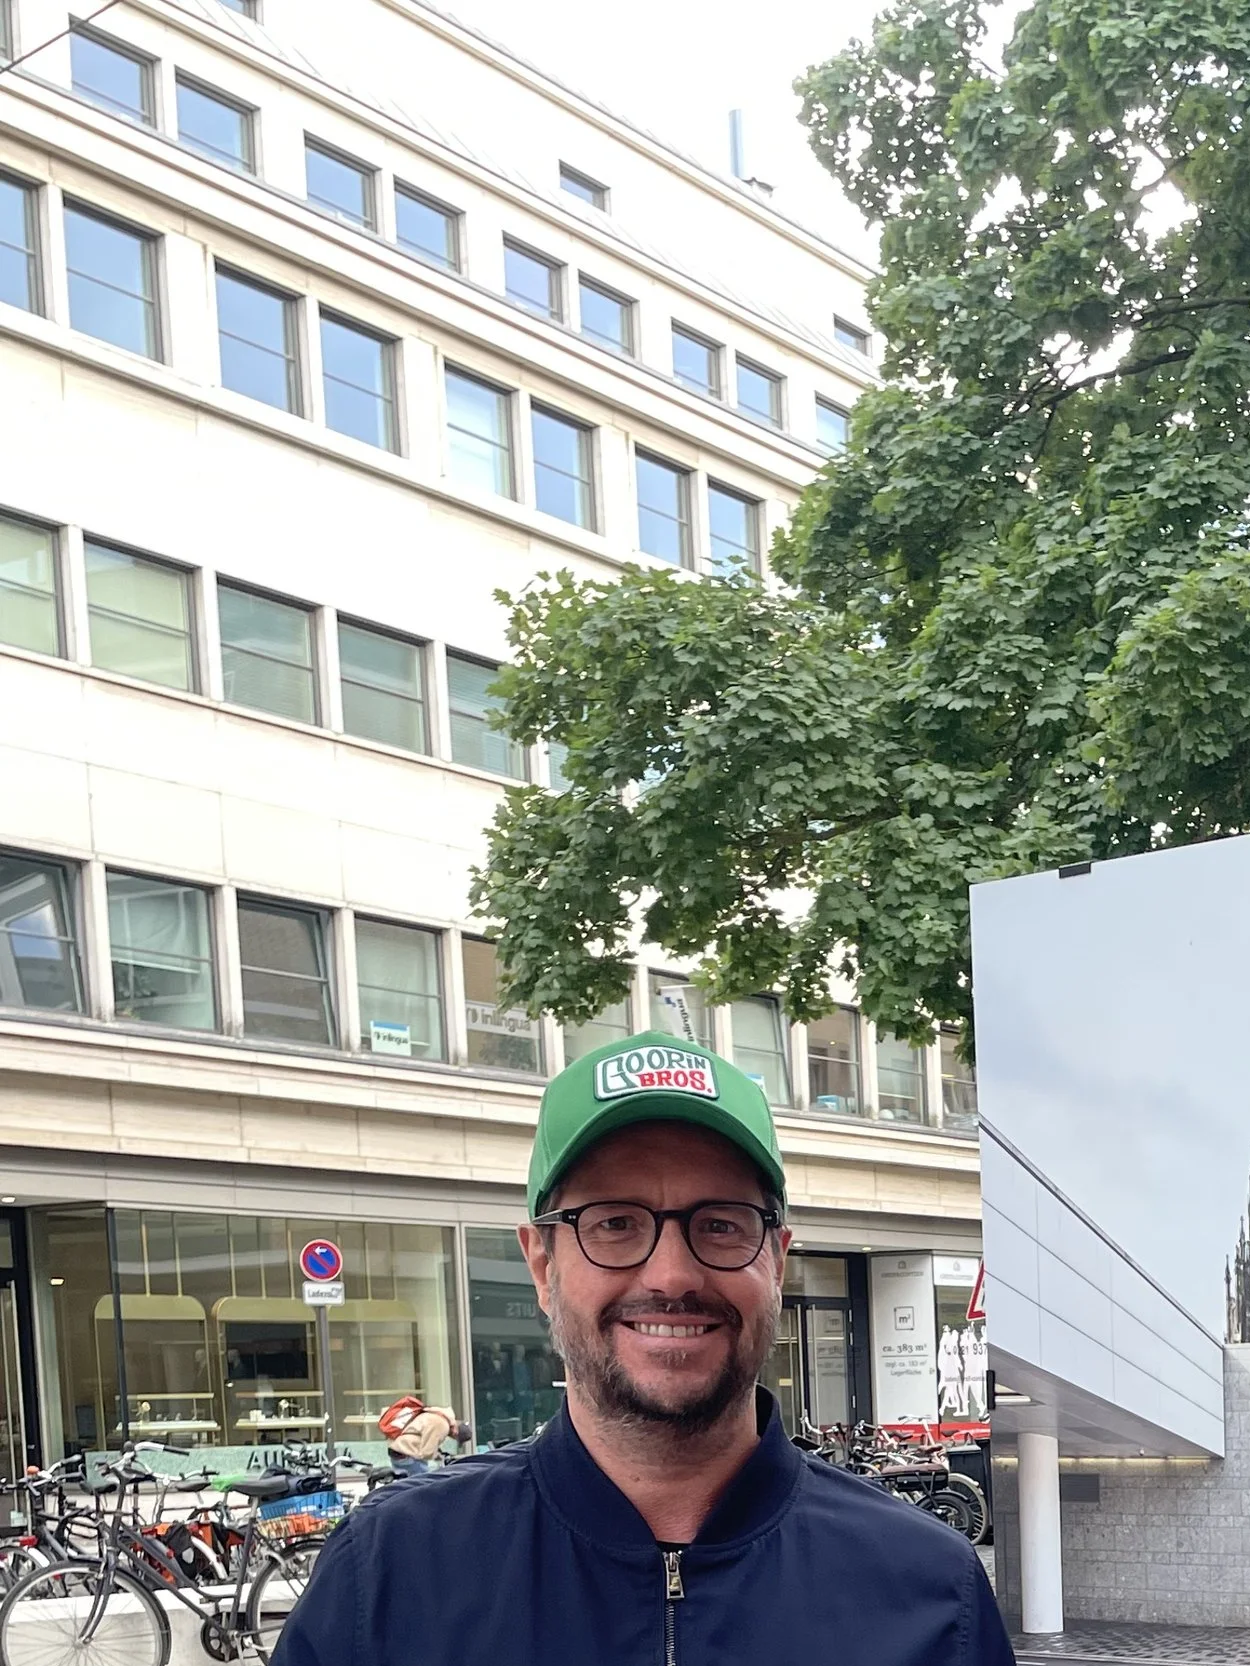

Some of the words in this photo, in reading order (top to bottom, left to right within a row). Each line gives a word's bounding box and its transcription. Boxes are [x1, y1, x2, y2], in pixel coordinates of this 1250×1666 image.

[481, 1008, 531, 1032] inlingua
[637, 1070, 712, 1093] BROS.
[897, 1344, 913, 1354] 383
